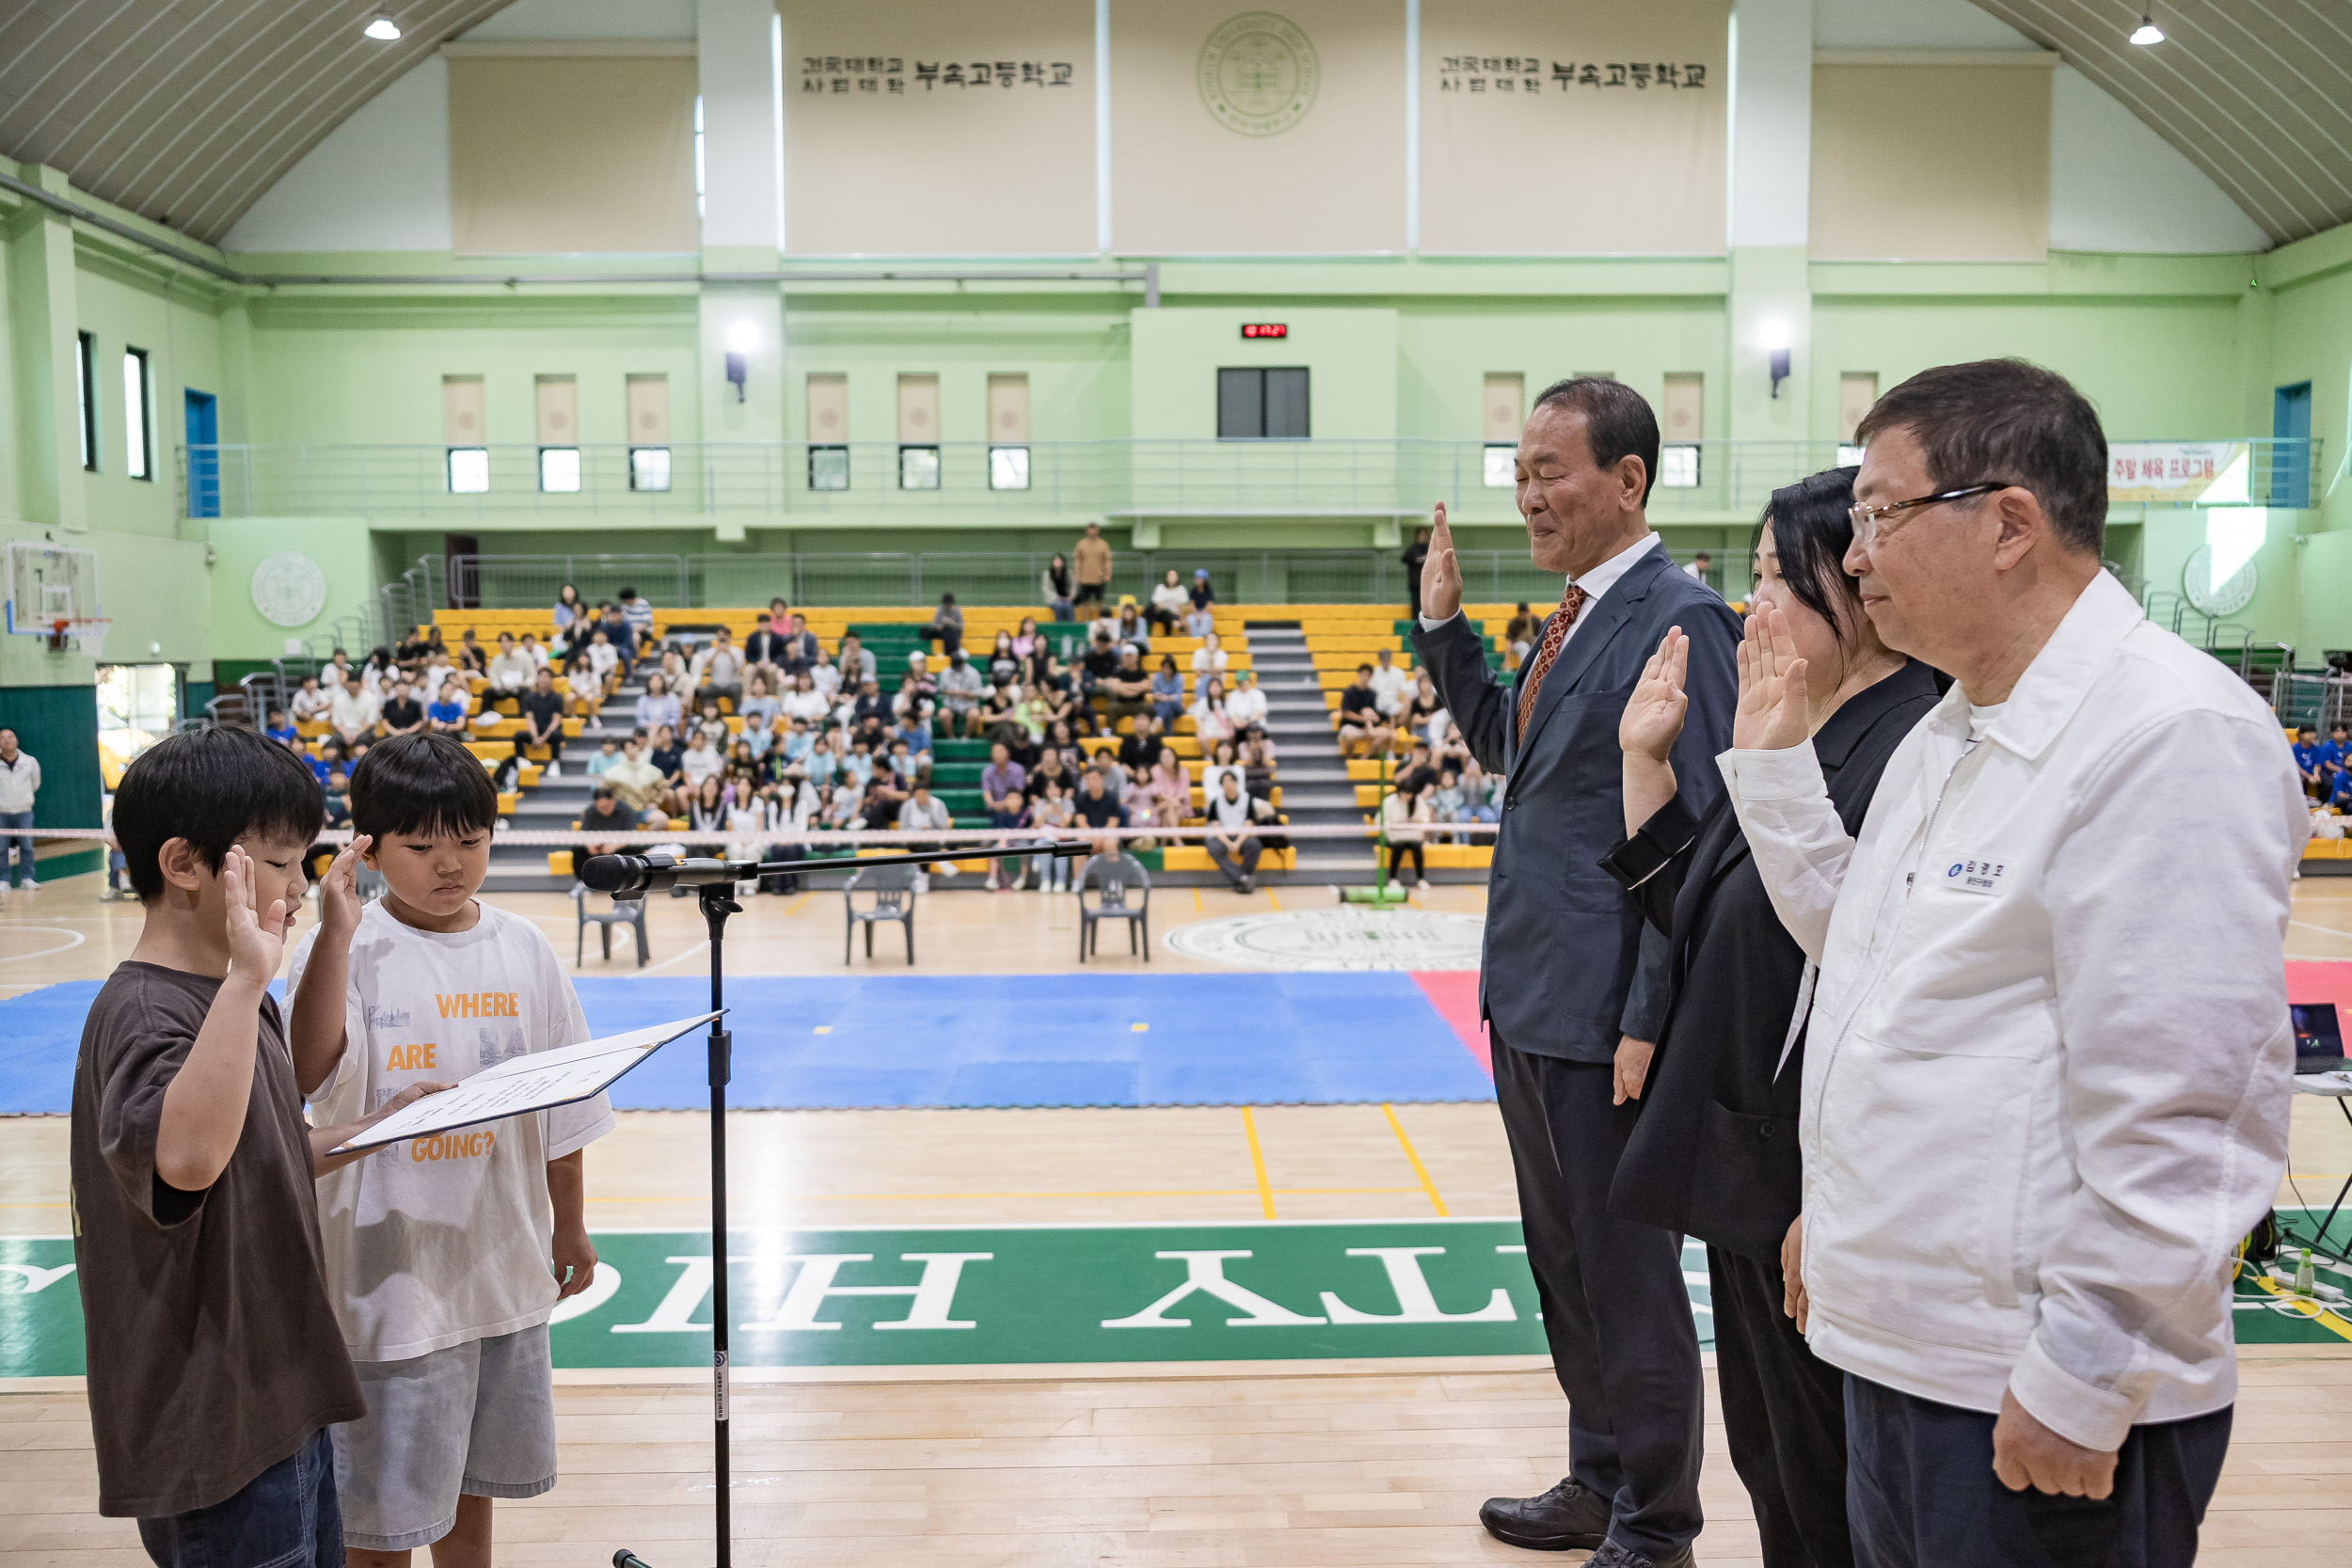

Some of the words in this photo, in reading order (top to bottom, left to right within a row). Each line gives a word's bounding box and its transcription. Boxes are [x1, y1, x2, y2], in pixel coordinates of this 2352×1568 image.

[914, 60, 1073, 92] 부속고등학교
[1550, 60, 1707, 91] 부속고등학교
[2114, 457, 2137, 480] 주말
[2141, 457, 2164, 480] 체육
[2169, 457, 2215, 480] 프로그램
[436, 992, 519, 1019] WHERE
[387, 1042, 437, 1071] ARE
[411, 1131, 495, 1163] GOING?
